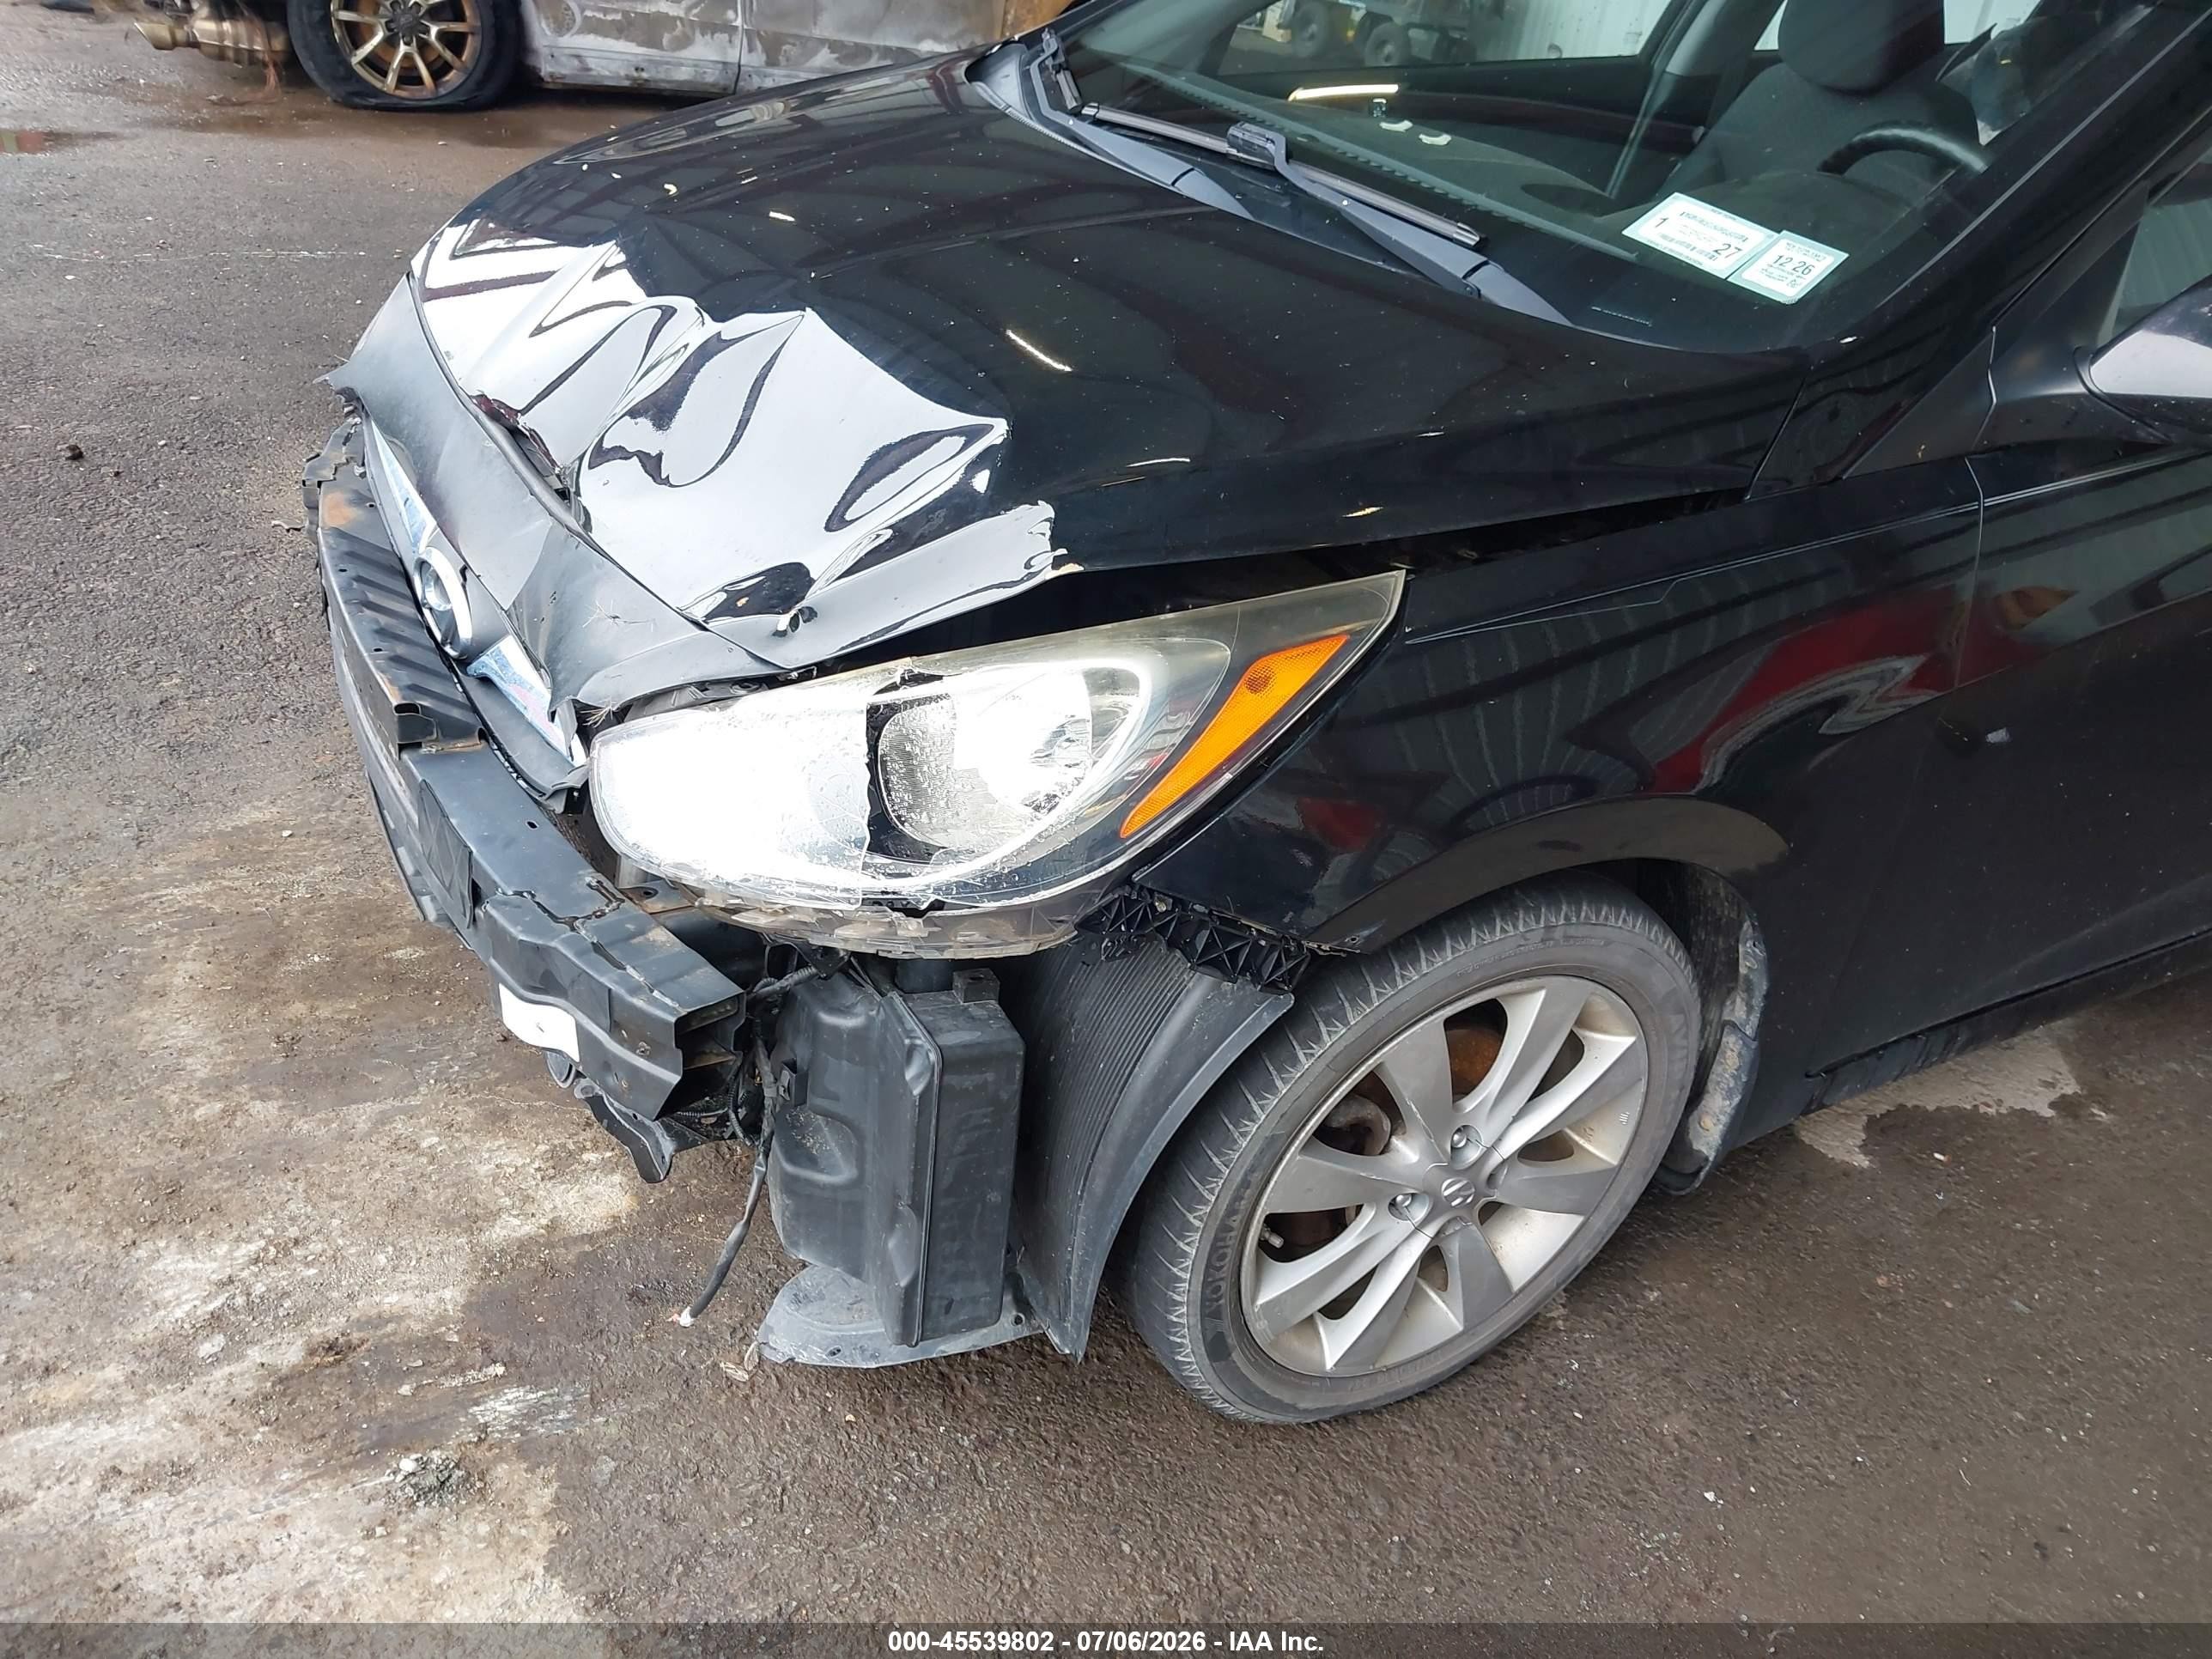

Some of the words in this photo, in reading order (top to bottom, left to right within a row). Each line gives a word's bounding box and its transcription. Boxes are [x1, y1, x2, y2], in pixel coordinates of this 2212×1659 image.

[1654, 216, 1669, 228] 1
[1712, 243, 1742, 258] 27
[1773, 254, 1794, 268] 12
[1792, 260, 1815, 276] 26
